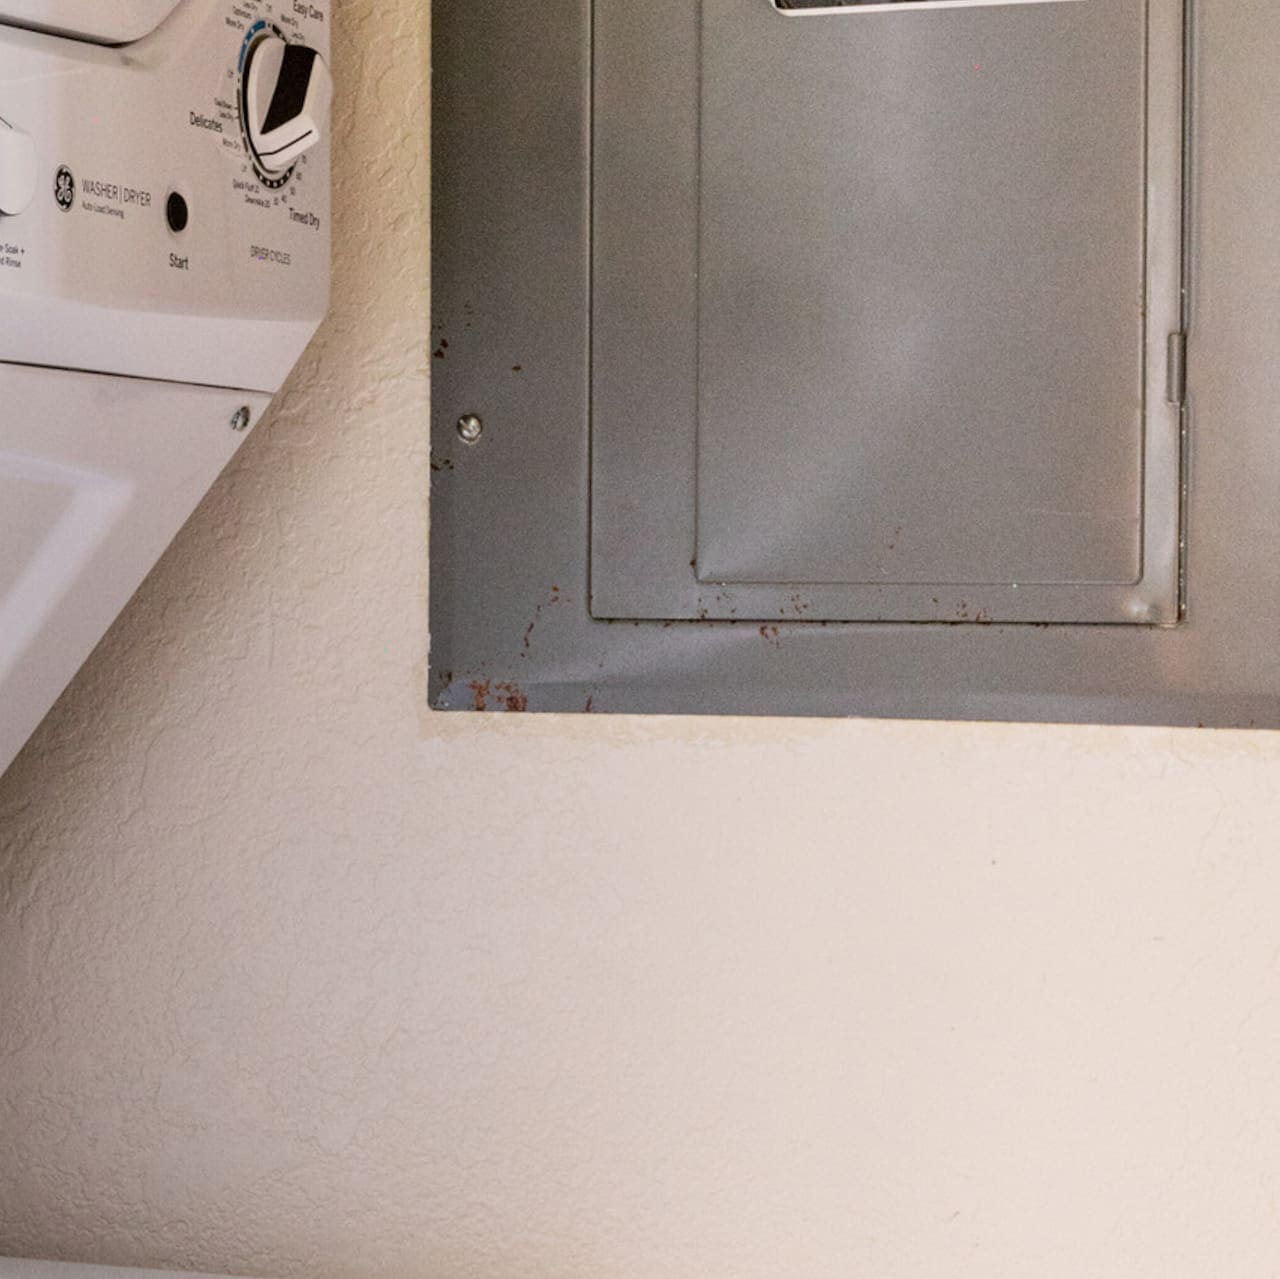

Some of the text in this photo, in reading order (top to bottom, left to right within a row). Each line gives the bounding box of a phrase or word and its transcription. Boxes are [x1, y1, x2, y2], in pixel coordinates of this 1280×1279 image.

[309, 4, 324, 22] Care
[190, 111, 223, 133] Delicates
[82, 180, 151, 207] WASHER DRYER
[288, 207, 320, 231] Timed Dry
[5, 242, 20, 255] Soak
[6, 256, 22, 269] Rinse
[169, 253, 189, 270] Start
